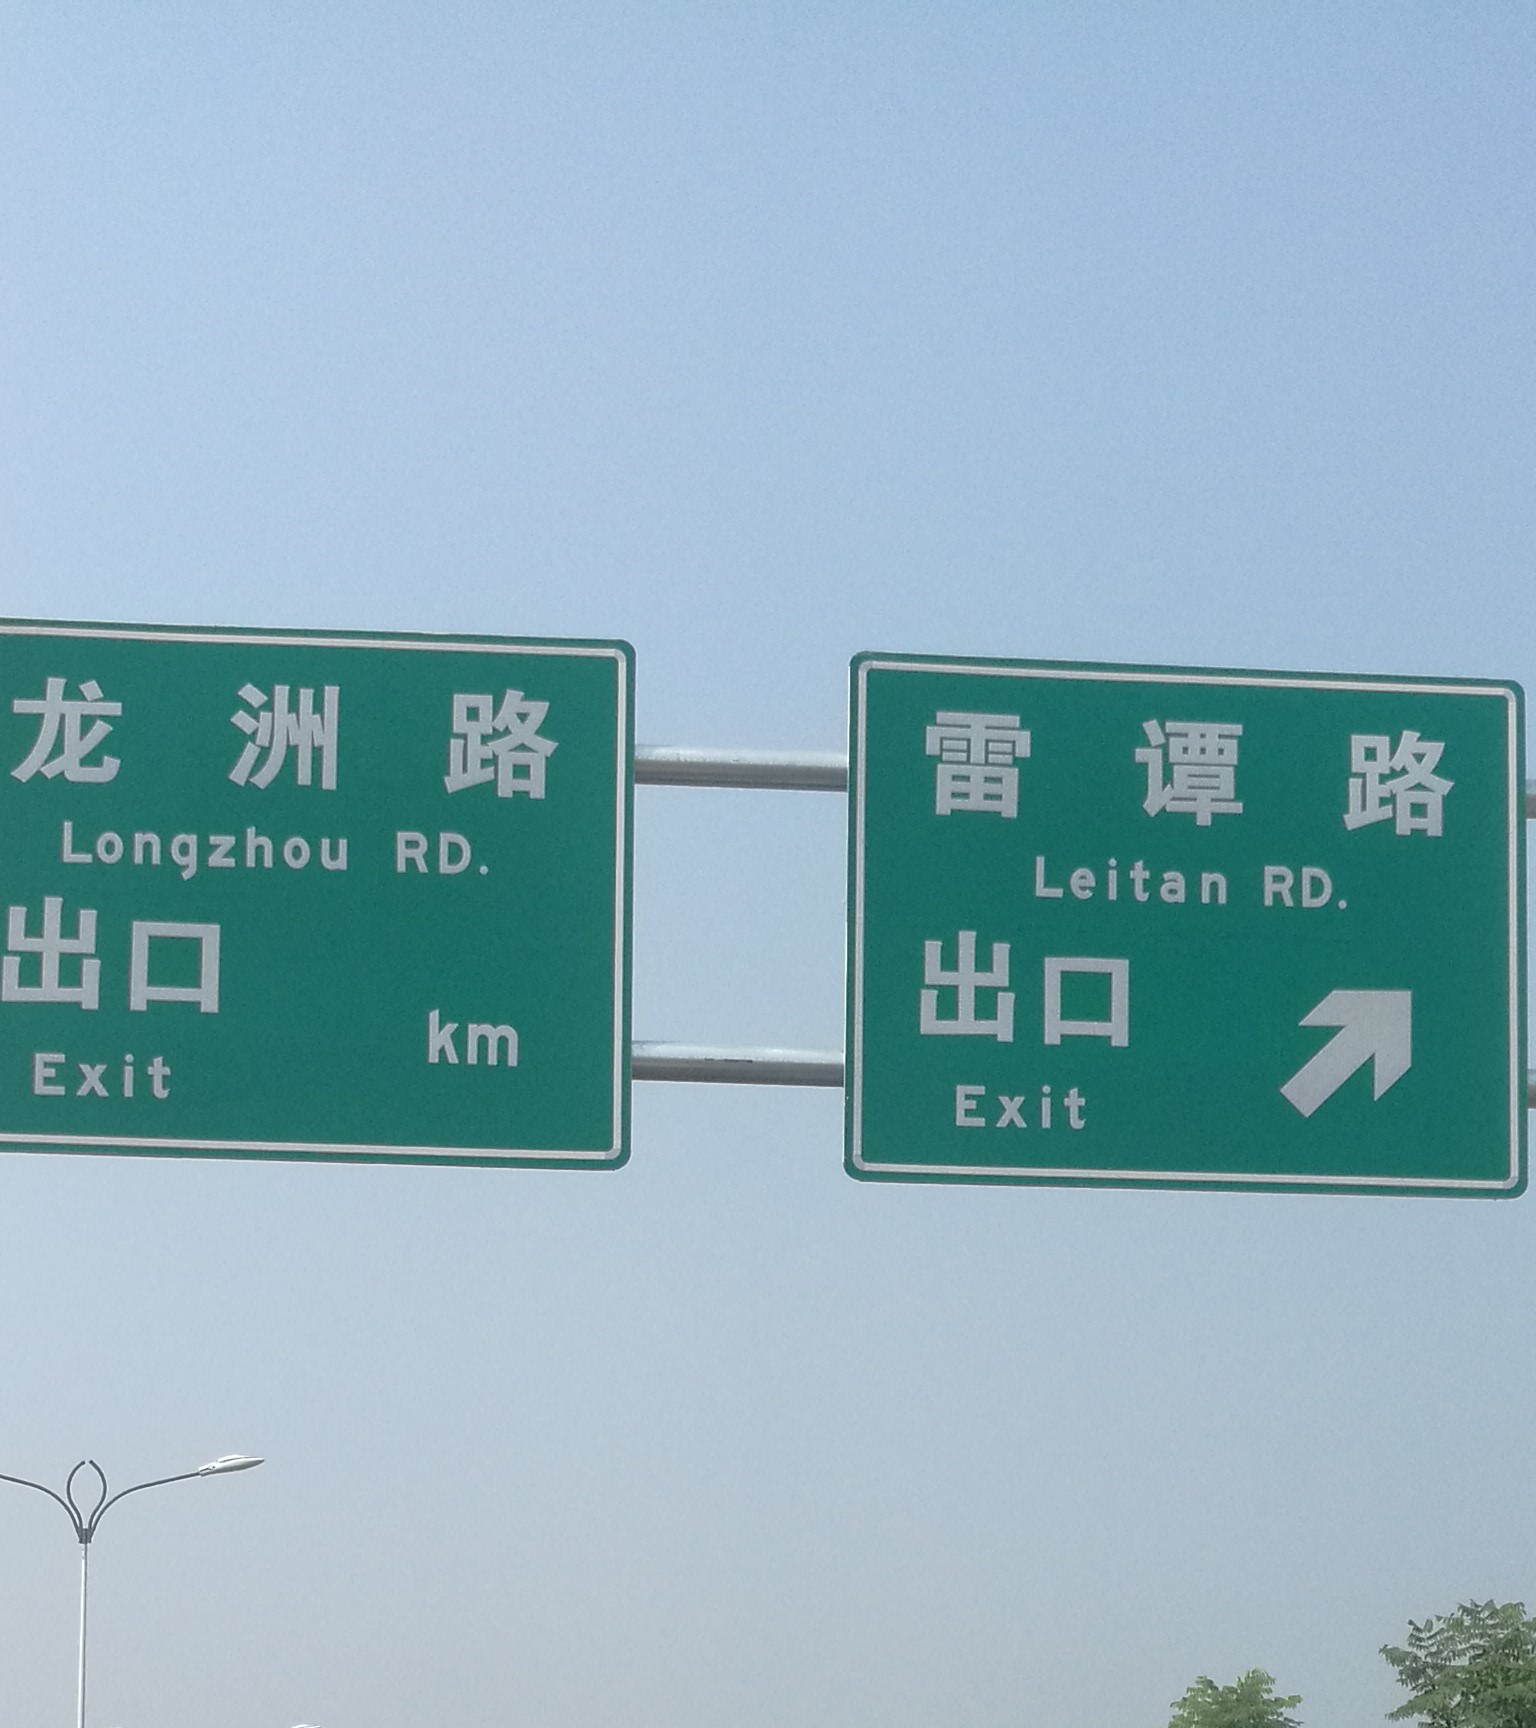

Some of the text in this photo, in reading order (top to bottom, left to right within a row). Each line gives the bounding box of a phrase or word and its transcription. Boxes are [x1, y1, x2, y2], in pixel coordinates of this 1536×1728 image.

[10, 676, 559, 800] 龙洲路
[924, 710, 1455, 838] 雷谭路
[61, 821, 490, 880] Longzhou RD.
[1034, 855, 1348, 911] Leitan RD.
[0, 896, 221, 1014] 出口
[919, 930, 1130, 1048] 出口
[427, 1009, 519, 1068] km
[32, 1053, 172, 1100] Exit
[955, 1084, 1087, 1130] Exit
